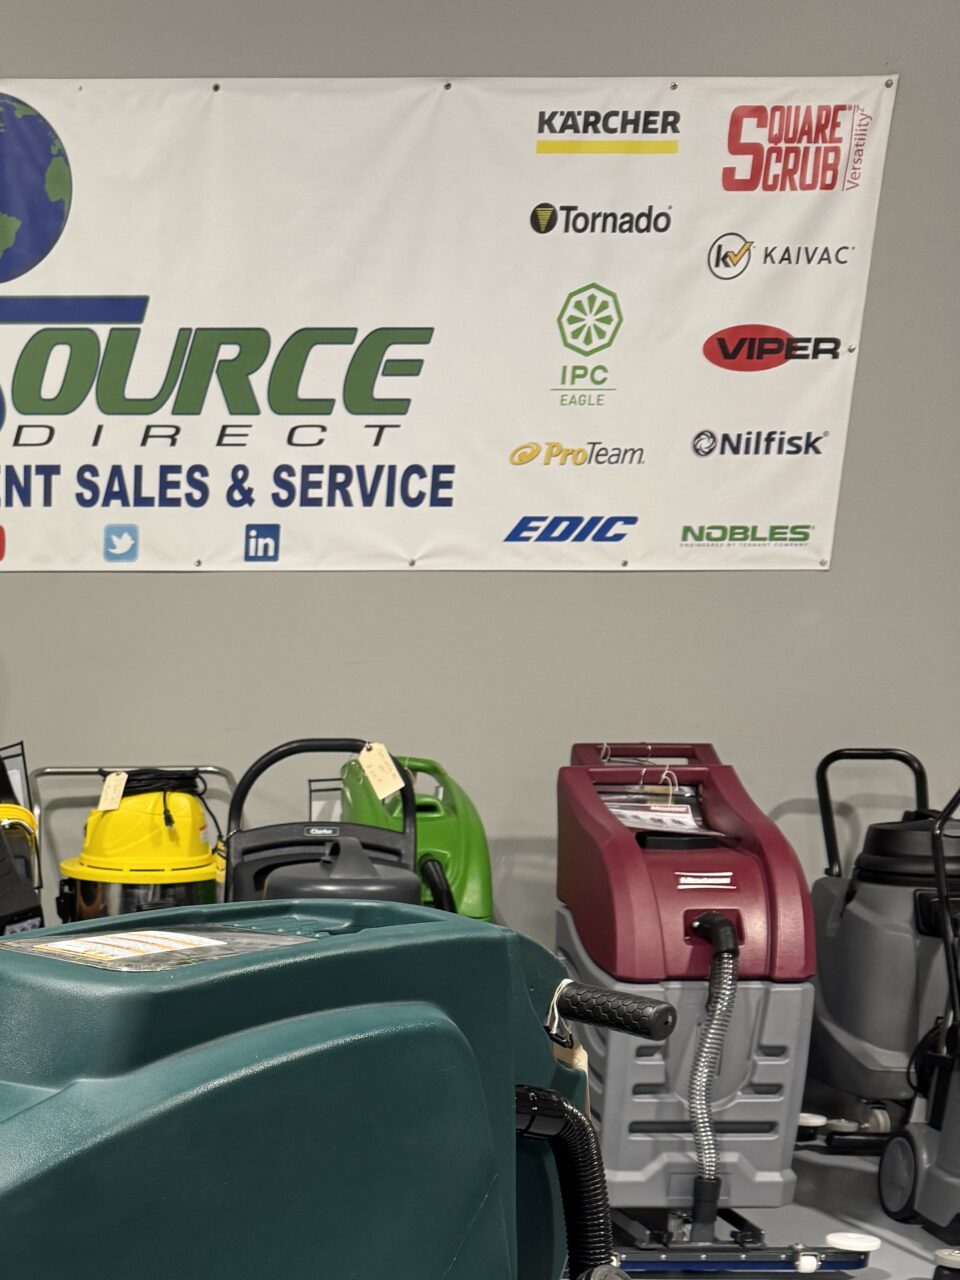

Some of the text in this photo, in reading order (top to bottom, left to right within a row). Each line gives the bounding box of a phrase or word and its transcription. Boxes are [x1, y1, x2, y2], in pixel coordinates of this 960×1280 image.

[537, 110, 681, 135] KÄRCHER
[559, 204, 672, 234] Tornado
[763, 245, 850, 265] KAIVAC
[716, 337, 842, 360] VIPER
[560, 364, 609, 386] IPC
[559, 393, 605, 407] EAGLE
[12, 424, 401, 448] DIRECT
[720, 430, 823, 456] Nilfisk
[543, 441, 644, 466] ProTeam
[74, 463, 210, 509] SALES
[225, 463, 256, 508] &
[271, 463, 456, 508] SERVICE
[503, 515, 639, 543] EDIC
[681, 524, 811, 542] NOBLES
